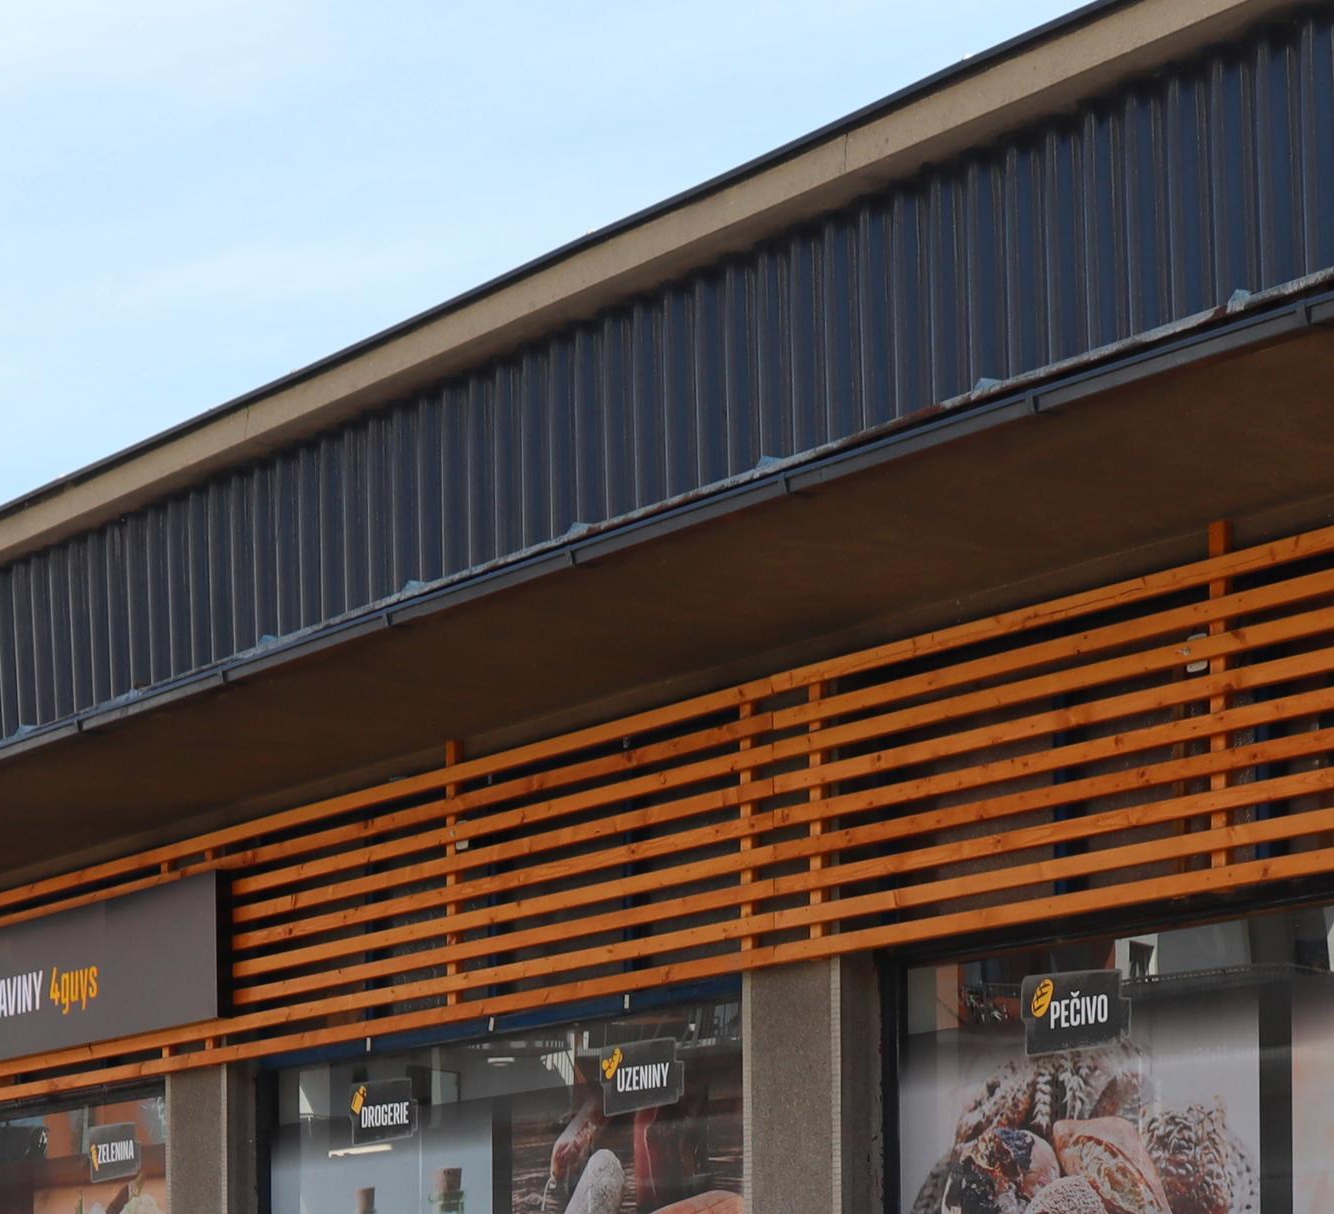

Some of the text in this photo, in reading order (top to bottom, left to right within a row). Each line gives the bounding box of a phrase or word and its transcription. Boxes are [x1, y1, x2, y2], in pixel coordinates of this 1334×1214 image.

[1049, 990, 1109, 1030] PEČIVO
[616, 1062, 670, 1093] UZENINY
[361, 1101, 410, 1128] DROGERIE
[97, 1139, 134, 1164] ZELENINA
